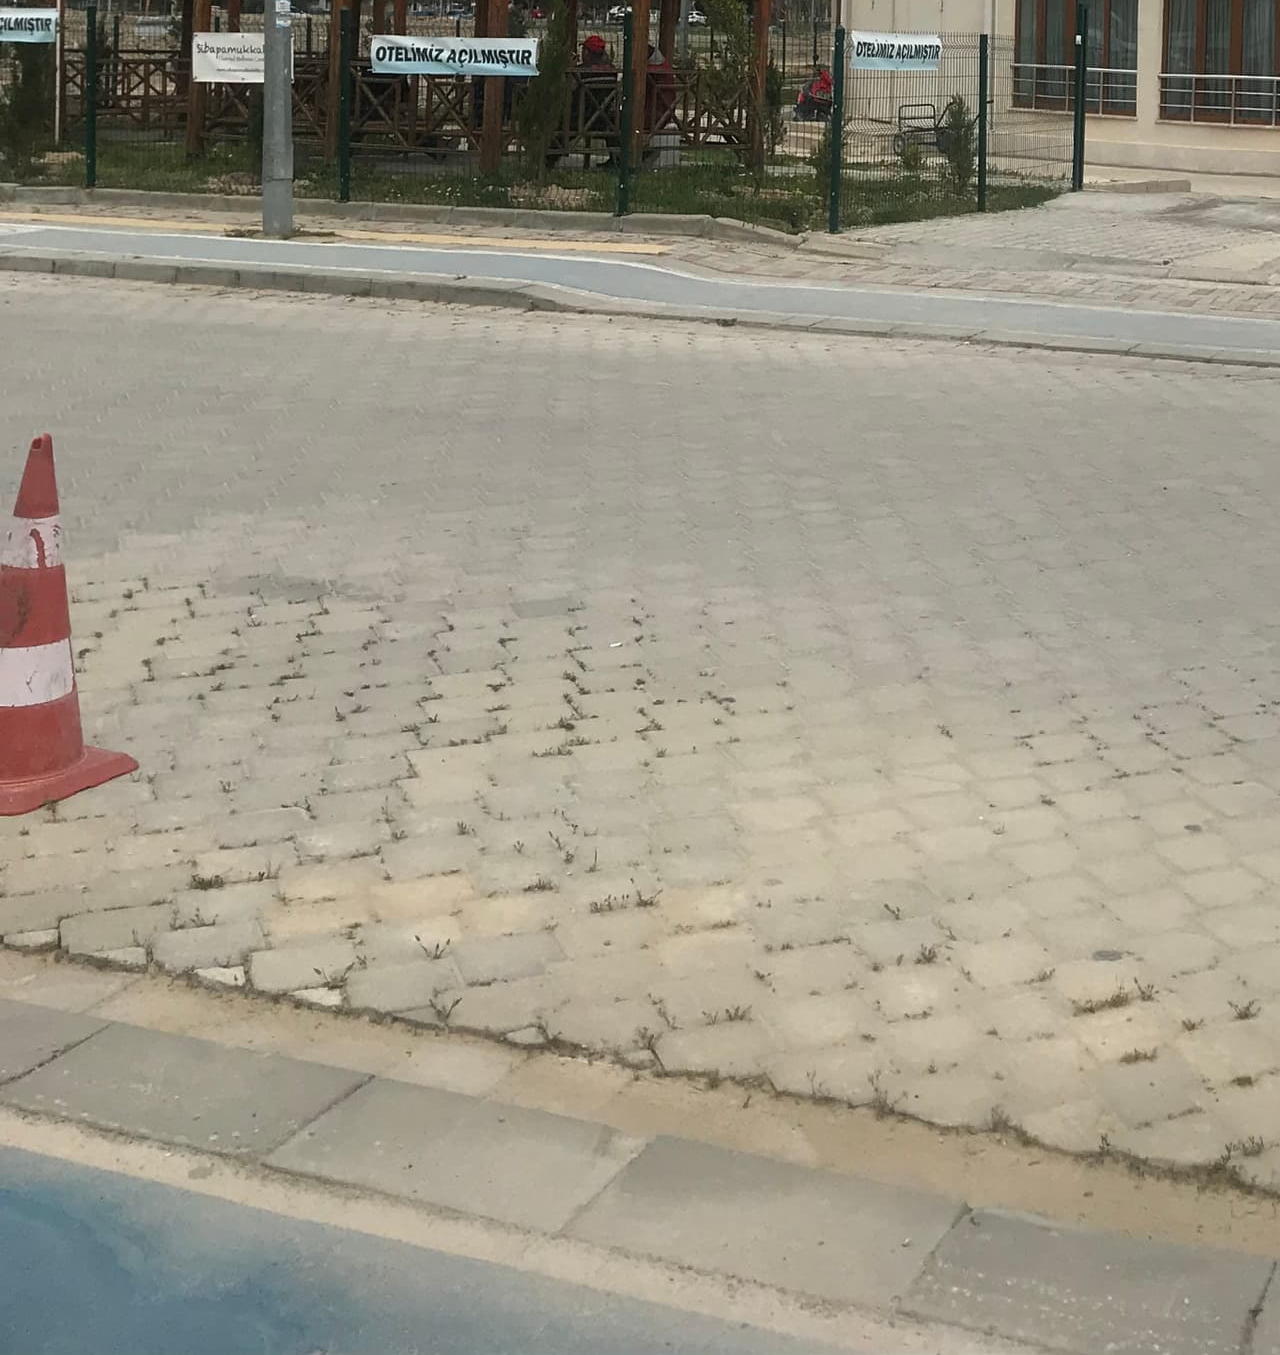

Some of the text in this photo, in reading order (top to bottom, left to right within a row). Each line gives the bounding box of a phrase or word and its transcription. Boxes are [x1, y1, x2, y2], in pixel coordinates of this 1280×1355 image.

[375, 43, 532, 68] OTELİMİZ AÇILMIŞTIR
[856, 39, 941, 64] OTELİMİZ AÇILMIŞTIR
